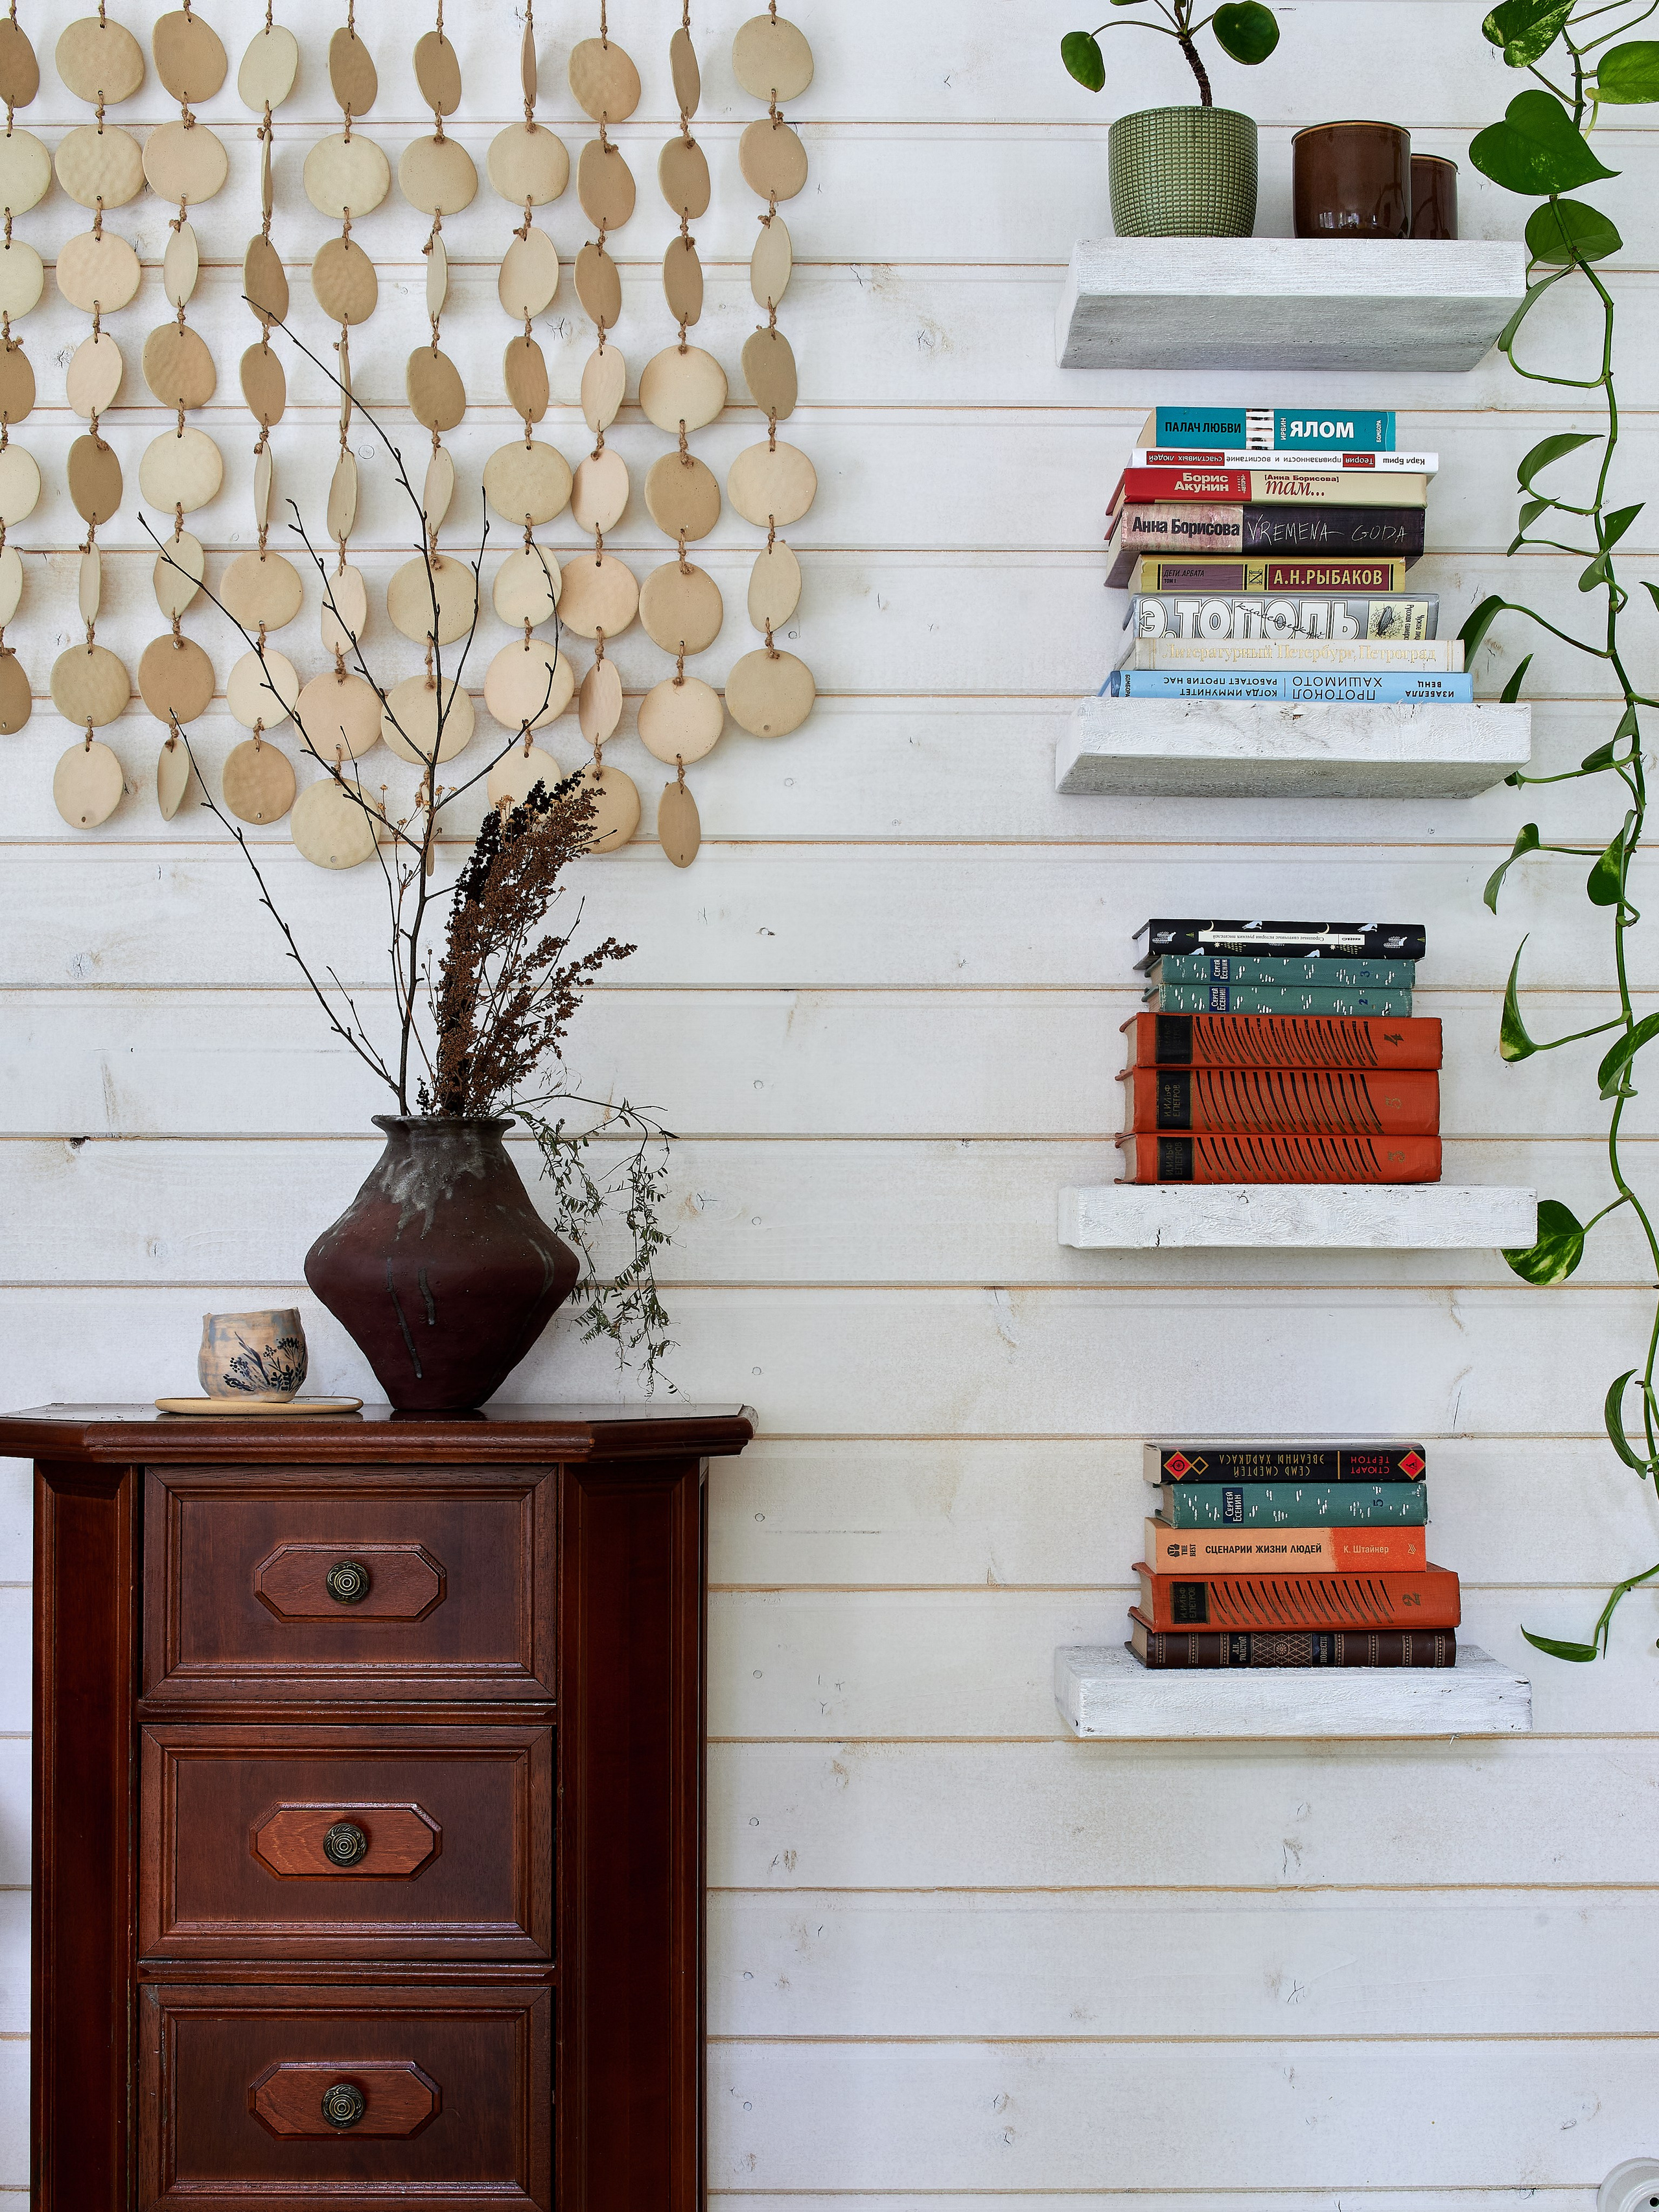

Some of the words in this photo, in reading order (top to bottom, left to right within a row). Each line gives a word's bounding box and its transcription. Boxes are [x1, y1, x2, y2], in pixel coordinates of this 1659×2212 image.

[1165, 422, 1200, 432] ПАЛАЧ
[1202, 423, 1241, 434] ЛЮБВИ
[1290, 421, 1354, 438] ЯЛОМ
[1345, 456, 1374, 465] Теория
[1383, 456, 1404, 465] Бриш
[1406, 456, 1425, 465] Карл
[1183, 472, 1229, 483] Борис
[1174, 482, 1229, 493] Акунин
[1131, 517, 1168, 533] Анна
[1171, 518, 1240, 539] Борисова
[1247, 514, 1345, 545] VREMENA
[1349, 525, 1408, 543] GODA
[1273, 570, 1383, 585] А.Н.РЫБАКОВ
[1162, 644, 1273, 662] Литературный
[1358, 645, 1436, 664] Петроград
[1292, 676, 1382, 688] ХАШИМОТО
[1180, 688, 1242, 697] ИММУНИТЕТ
[1292, 689, 1376, 700] ПРОТОКОЛ
[1384, 1034, 1404, 1047] 4
[1219, 1454, 1271, 1465] ХАРДКАСЛ
[1278, 1454, 1325, 1465] ЭВЕЛИНЫ
[1351, 1456, 1389, 1465] ТЁРТОН
[1234, 1466, 1279, 1478] СМЕРТЕЙ
[1285, 1466, 1310, 1476] СЕМЬ
[1225, 1491, 1234, 1517] СЕРГЕЙ
[1233, 1495, 1242, 1522] ЕСЕНИН
[1373, 1498, 1384, 1508] 5
[1205, 1545, 1253, 1555] СЦЕНАРИИ
[1255, 1545, 1287, 1554] ЖИЗНИ
[1290, 1543, 1322, 1554] ЛЮДЕЙ
[1343, 1545, 1351, 1554] К.
[1353, 1545, 1389, 1554] Штайнер
[1403, 1592, 1422, 1607] 2
[1238, 1636, 1247, 1662] ТОЛСТОЙ
[1319, 1636, 1328, 1663] ПОВЕСТИ
